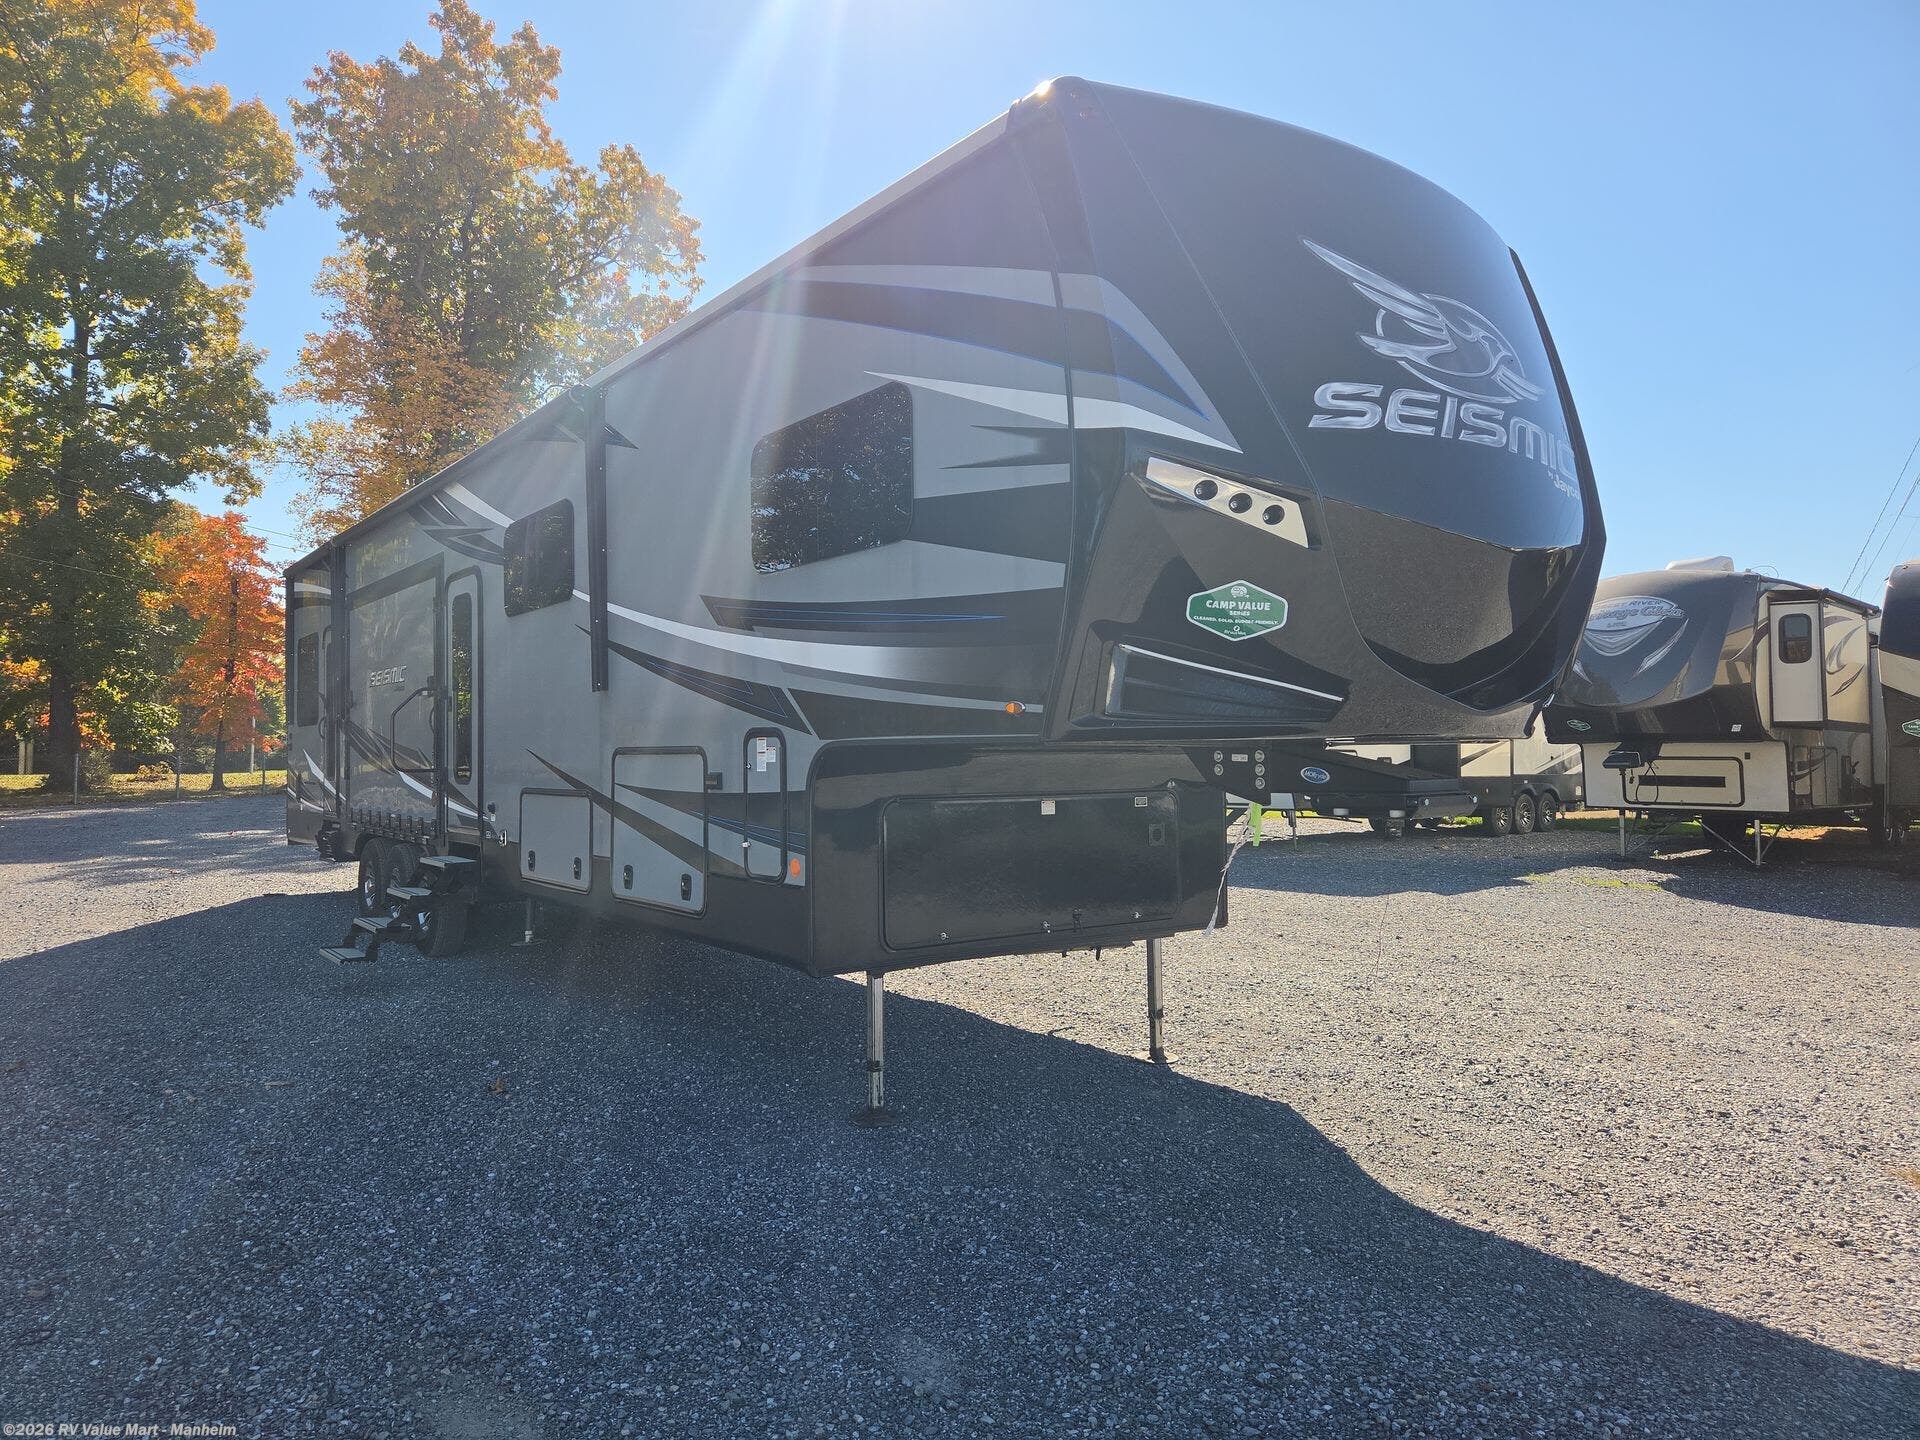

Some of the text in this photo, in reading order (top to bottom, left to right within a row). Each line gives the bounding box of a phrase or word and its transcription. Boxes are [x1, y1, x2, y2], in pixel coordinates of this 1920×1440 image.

[1308, 382, 1577, 481] SEISMIC
[1206, 600, 1271, 610] CAMP VALUE
[370, 665, 407, 686] SEISMIC
